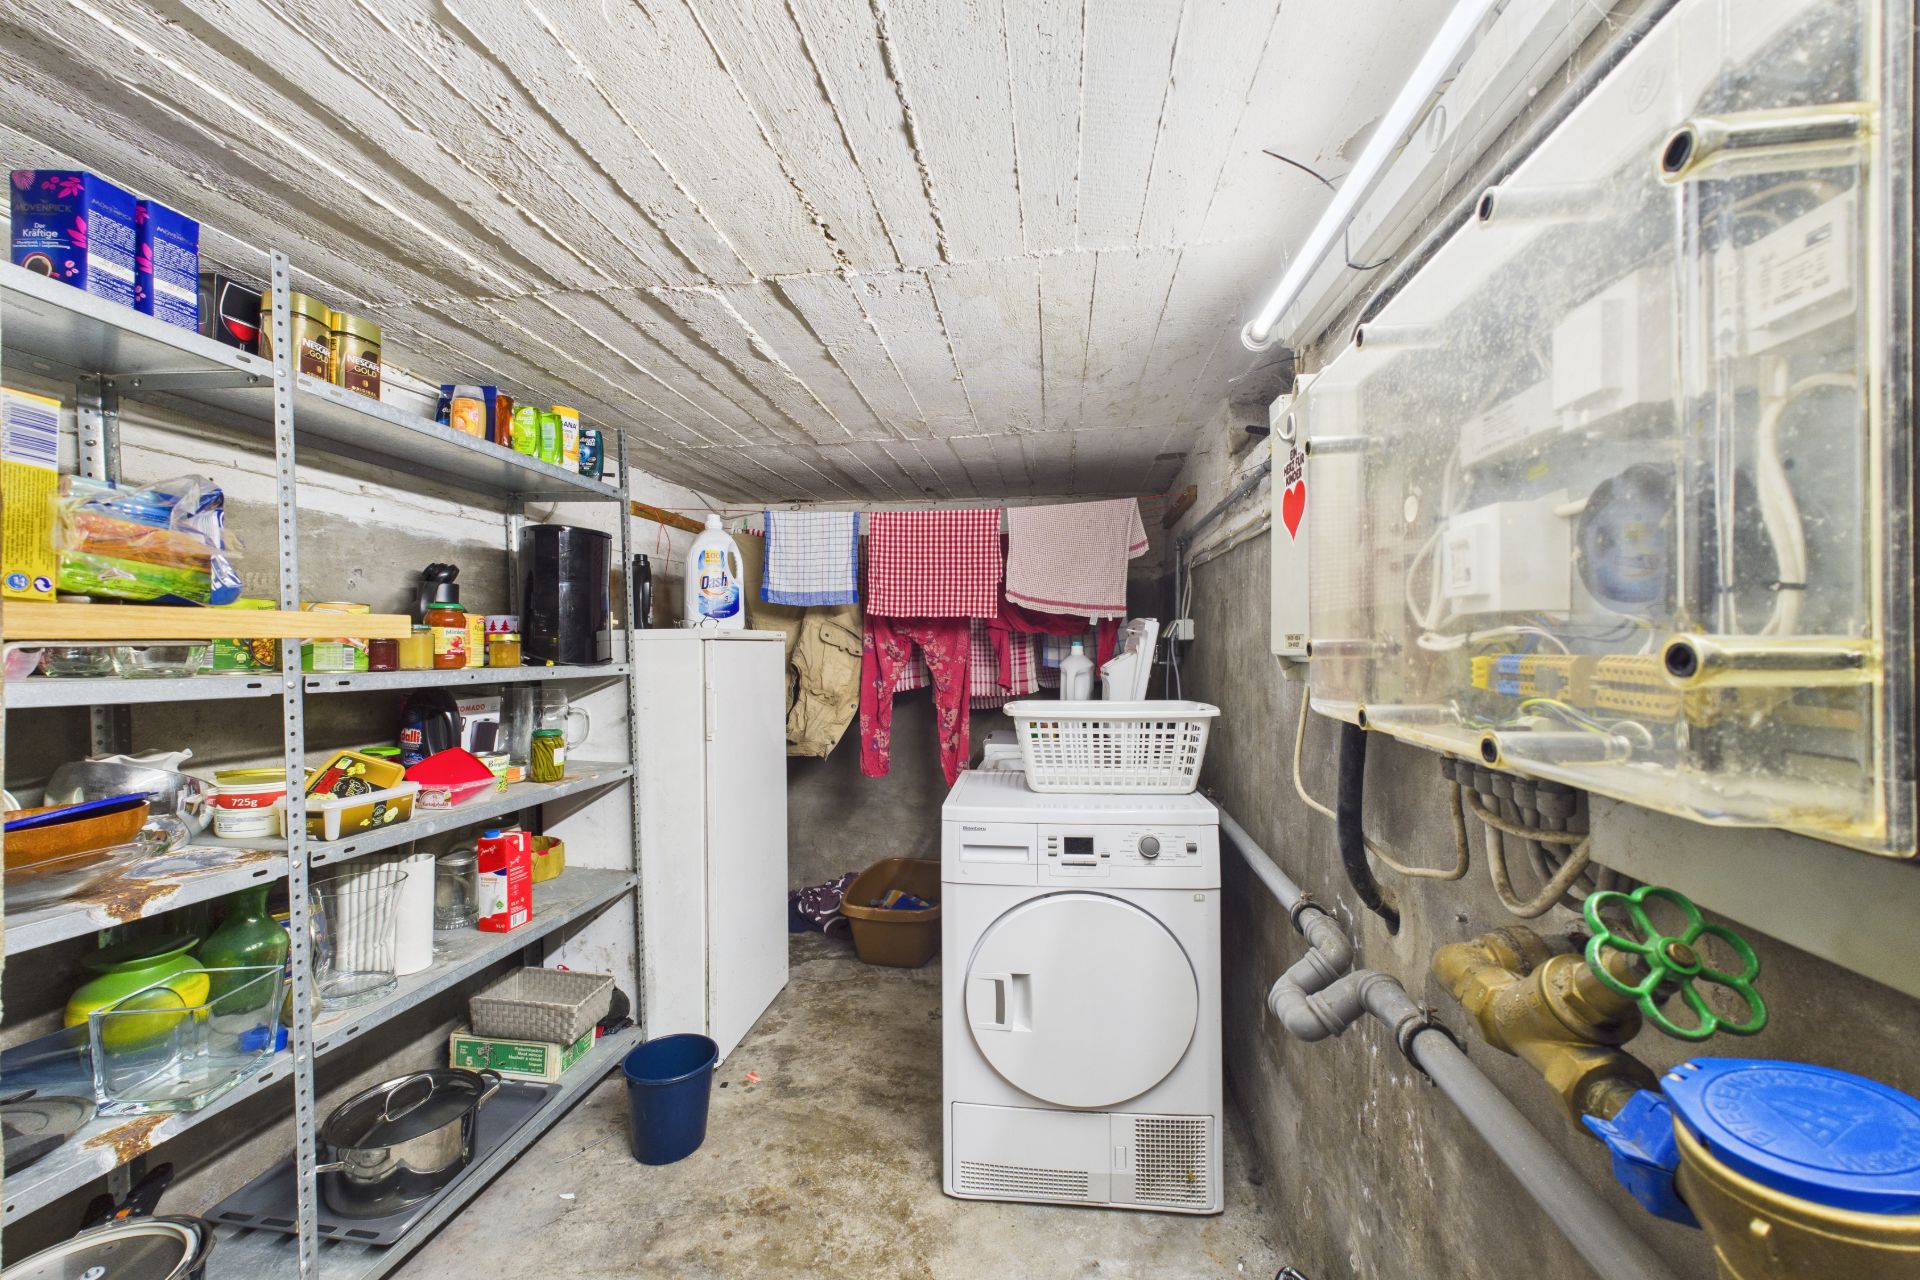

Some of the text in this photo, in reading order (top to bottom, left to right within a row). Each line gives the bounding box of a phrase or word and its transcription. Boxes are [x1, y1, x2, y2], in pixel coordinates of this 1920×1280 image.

[22, 228, 59, 239] Kräftige
[309, 349, 329, 364] GOLD
[354, 364, 378, 378] GOLD
[1284, 452, 1304, 477] HERZ FÜR
[1286, 467, 1302, 487] KINDER
[701, 571, 728, 590] Dash
[459, 703, 486, 713] OMADO
[400, 728, 422, 743] dalli
[231, 797, 258, 808] 725g
[466, 1056, 474, 1066] 5
